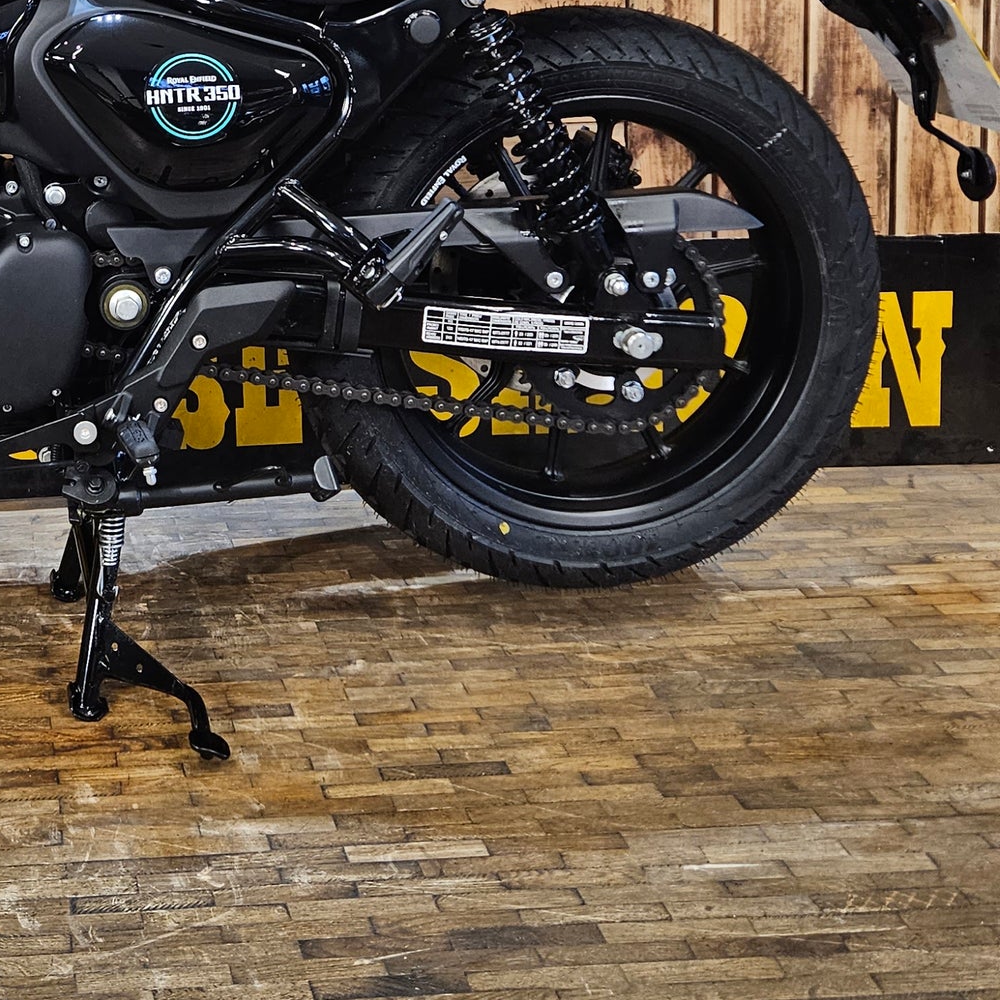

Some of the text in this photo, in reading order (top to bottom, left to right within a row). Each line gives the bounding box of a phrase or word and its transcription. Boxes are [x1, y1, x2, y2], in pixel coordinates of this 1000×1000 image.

[167, 75, 217, 85] ROYAL ENFIELD
[146, 85, 241, 105] HNTR 350
[443, 155, 467, 177] ROYAL
